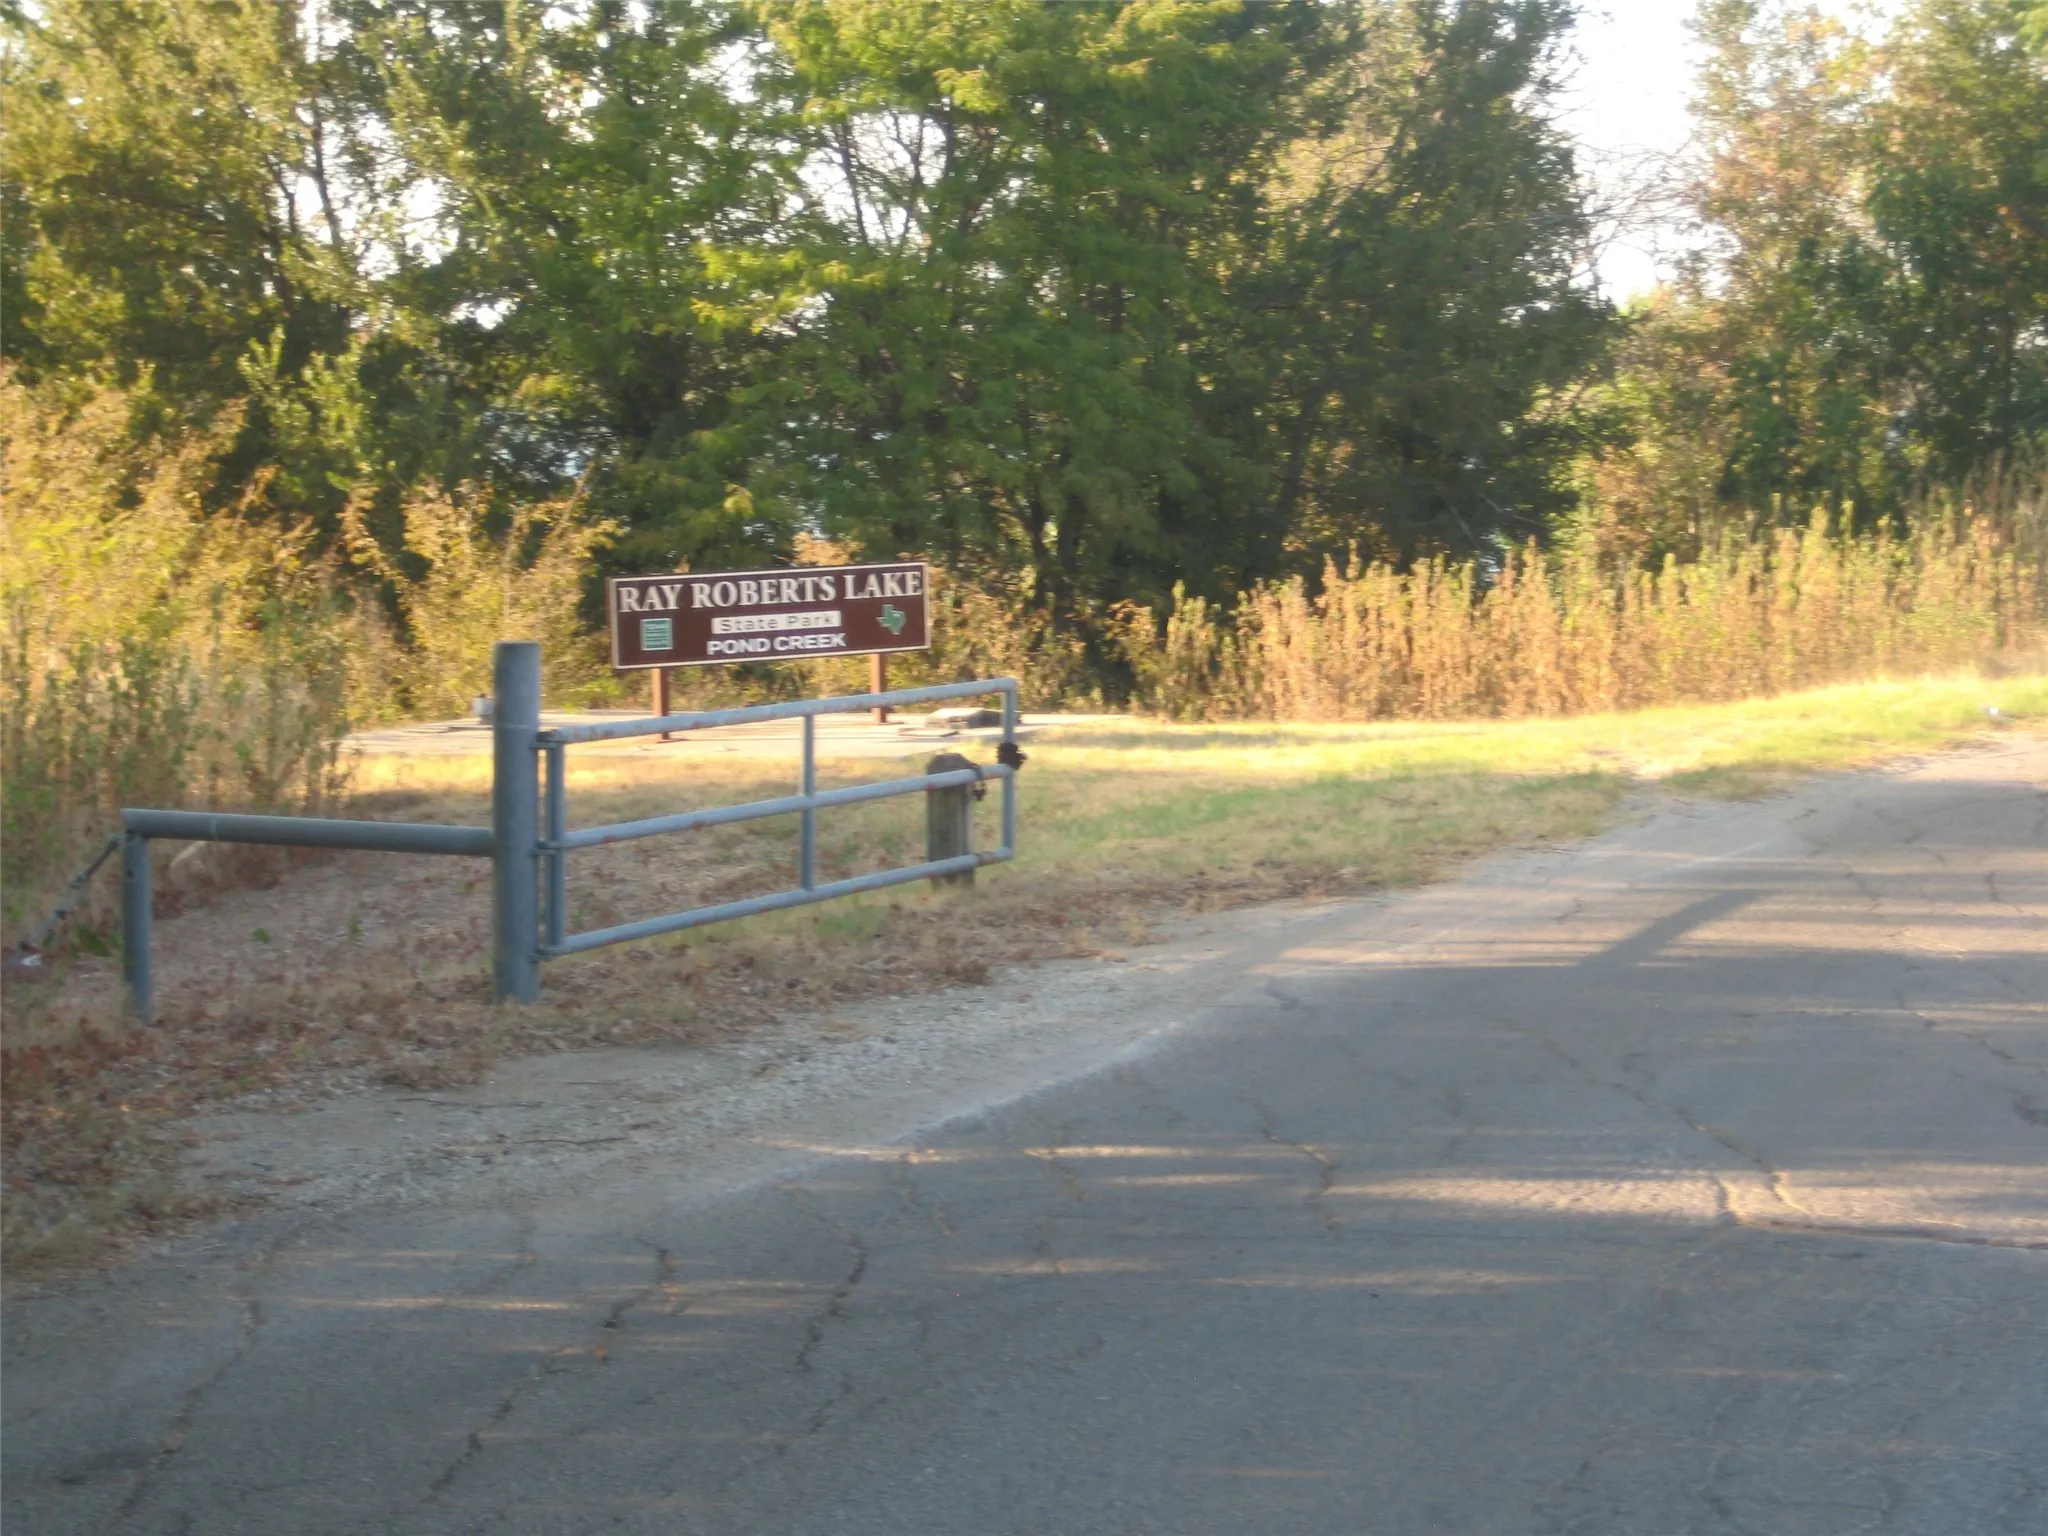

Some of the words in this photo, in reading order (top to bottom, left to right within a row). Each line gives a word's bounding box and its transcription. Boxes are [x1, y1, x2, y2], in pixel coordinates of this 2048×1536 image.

[619, 584, 683, 613] RAY
[690, 576, 836, 609] ROBERTS
[844, 571, 923, 600] LAKE
[719, 616, 778, 632] State
[788, 613, 834, 628] Park
[706, 636, 771, 655] POND
[773, 633, 847, 651] CREEK
